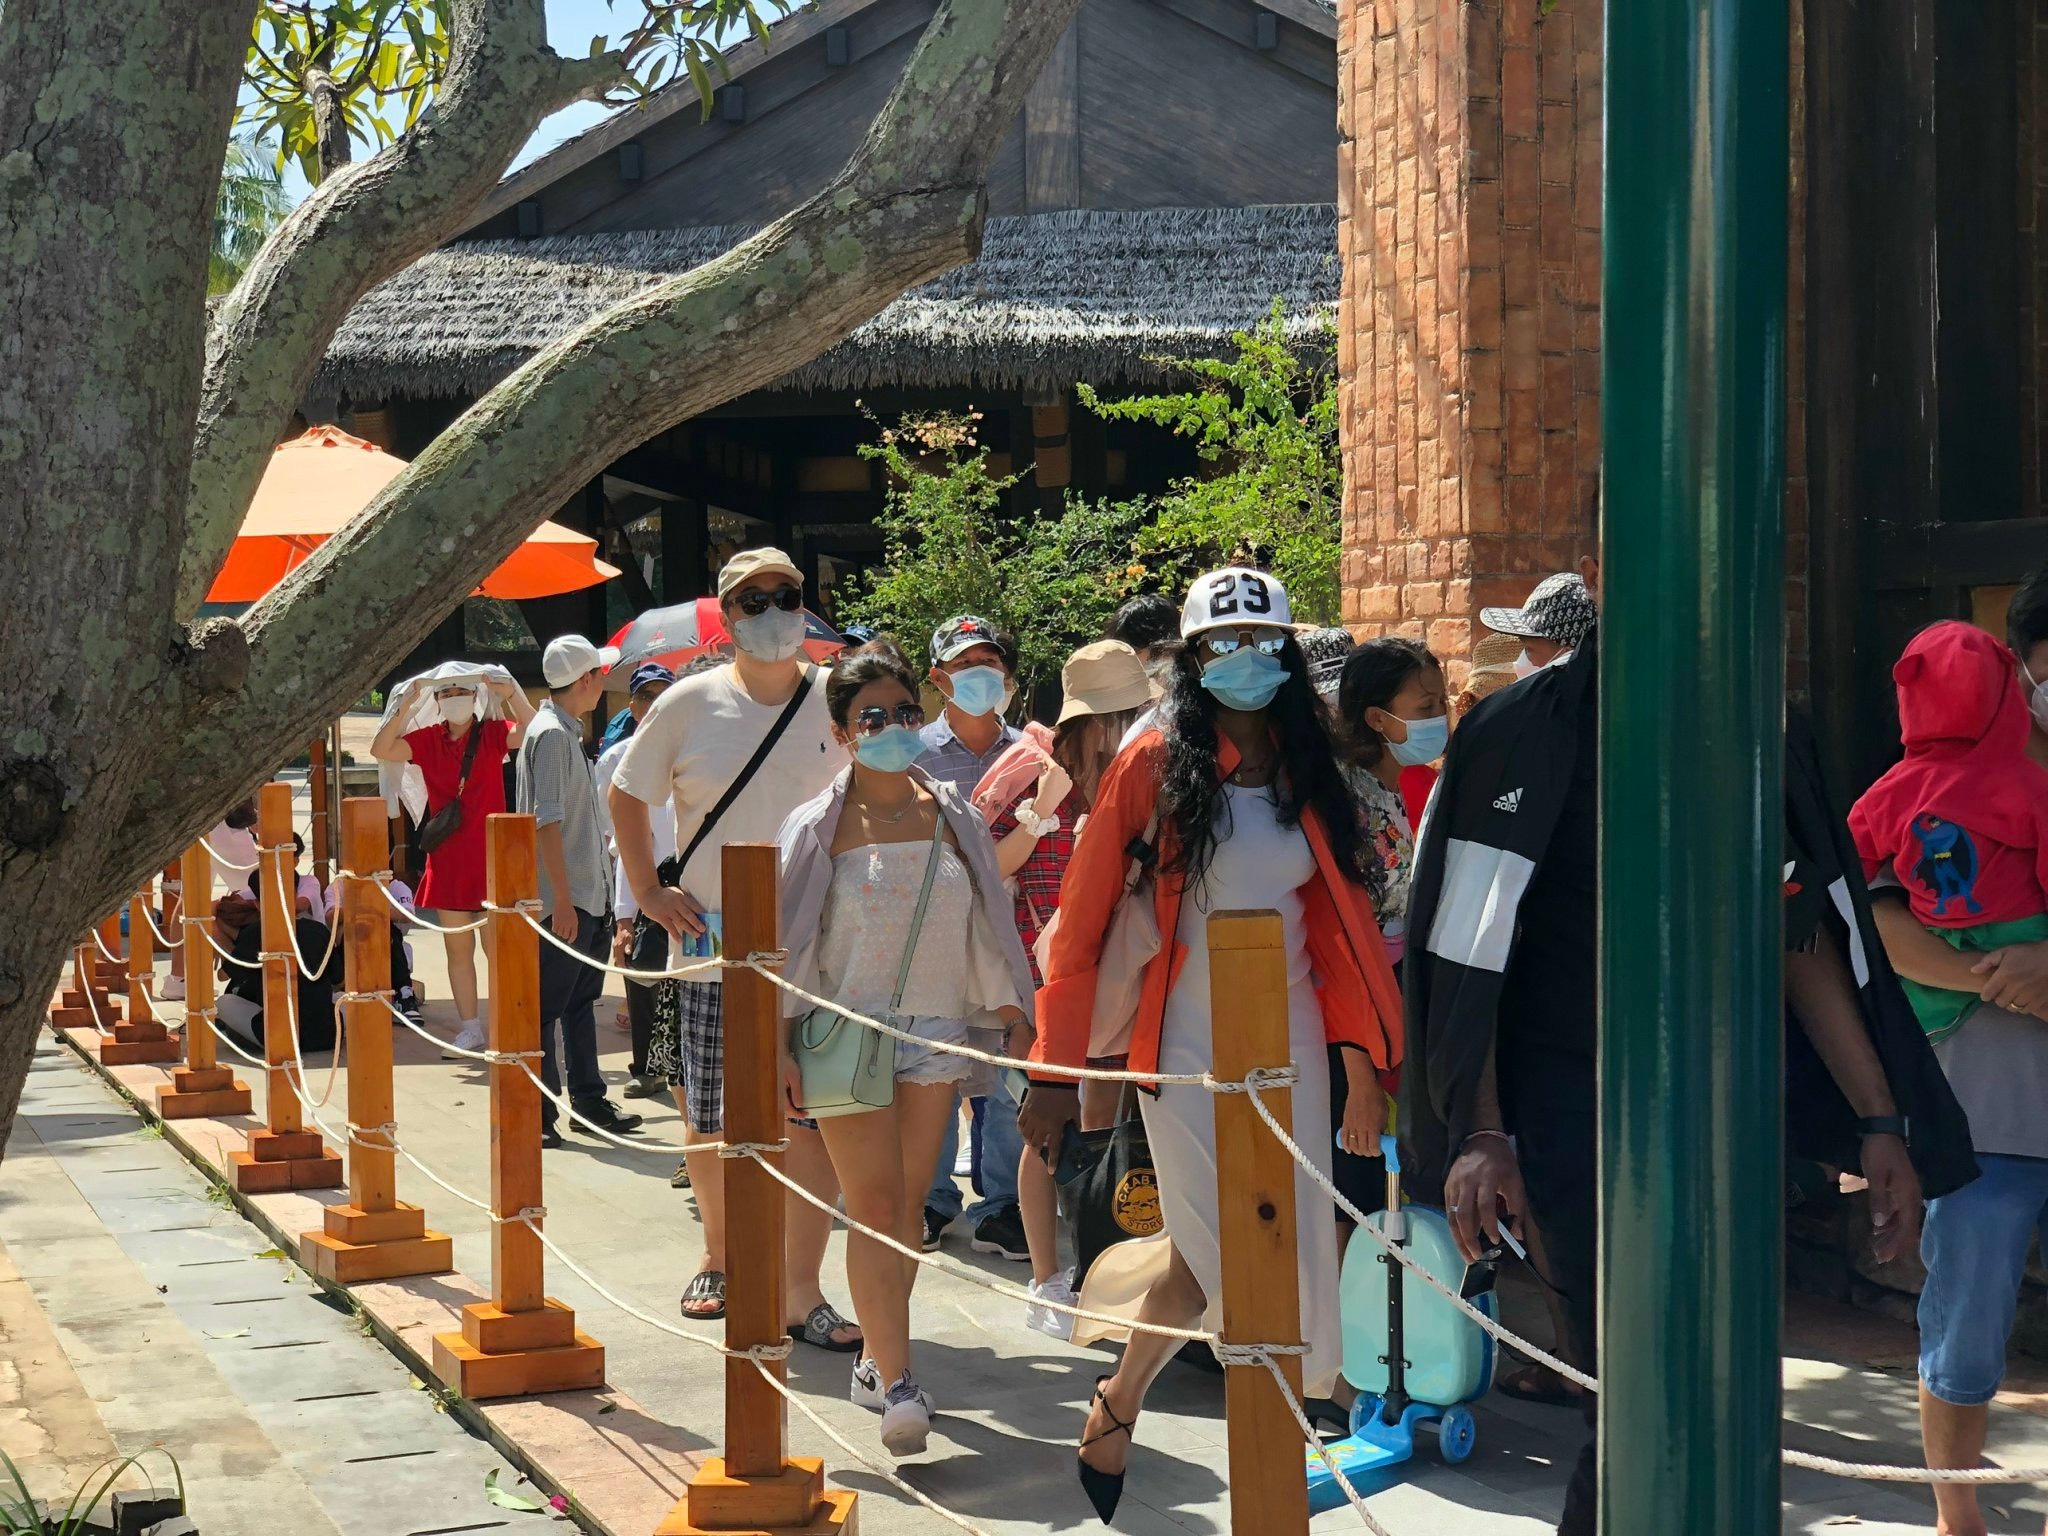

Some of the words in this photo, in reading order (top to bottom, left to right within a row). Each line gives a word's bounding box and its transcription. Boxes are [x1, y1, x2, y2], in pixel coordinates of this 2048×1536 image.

[1209, 573, 1271, 618] 23
[1492, 799, 1518, 813] adid
[1119, 1175, 1149, 1203] CRAB
[1127, 1217, 1164, 1231] STORE
